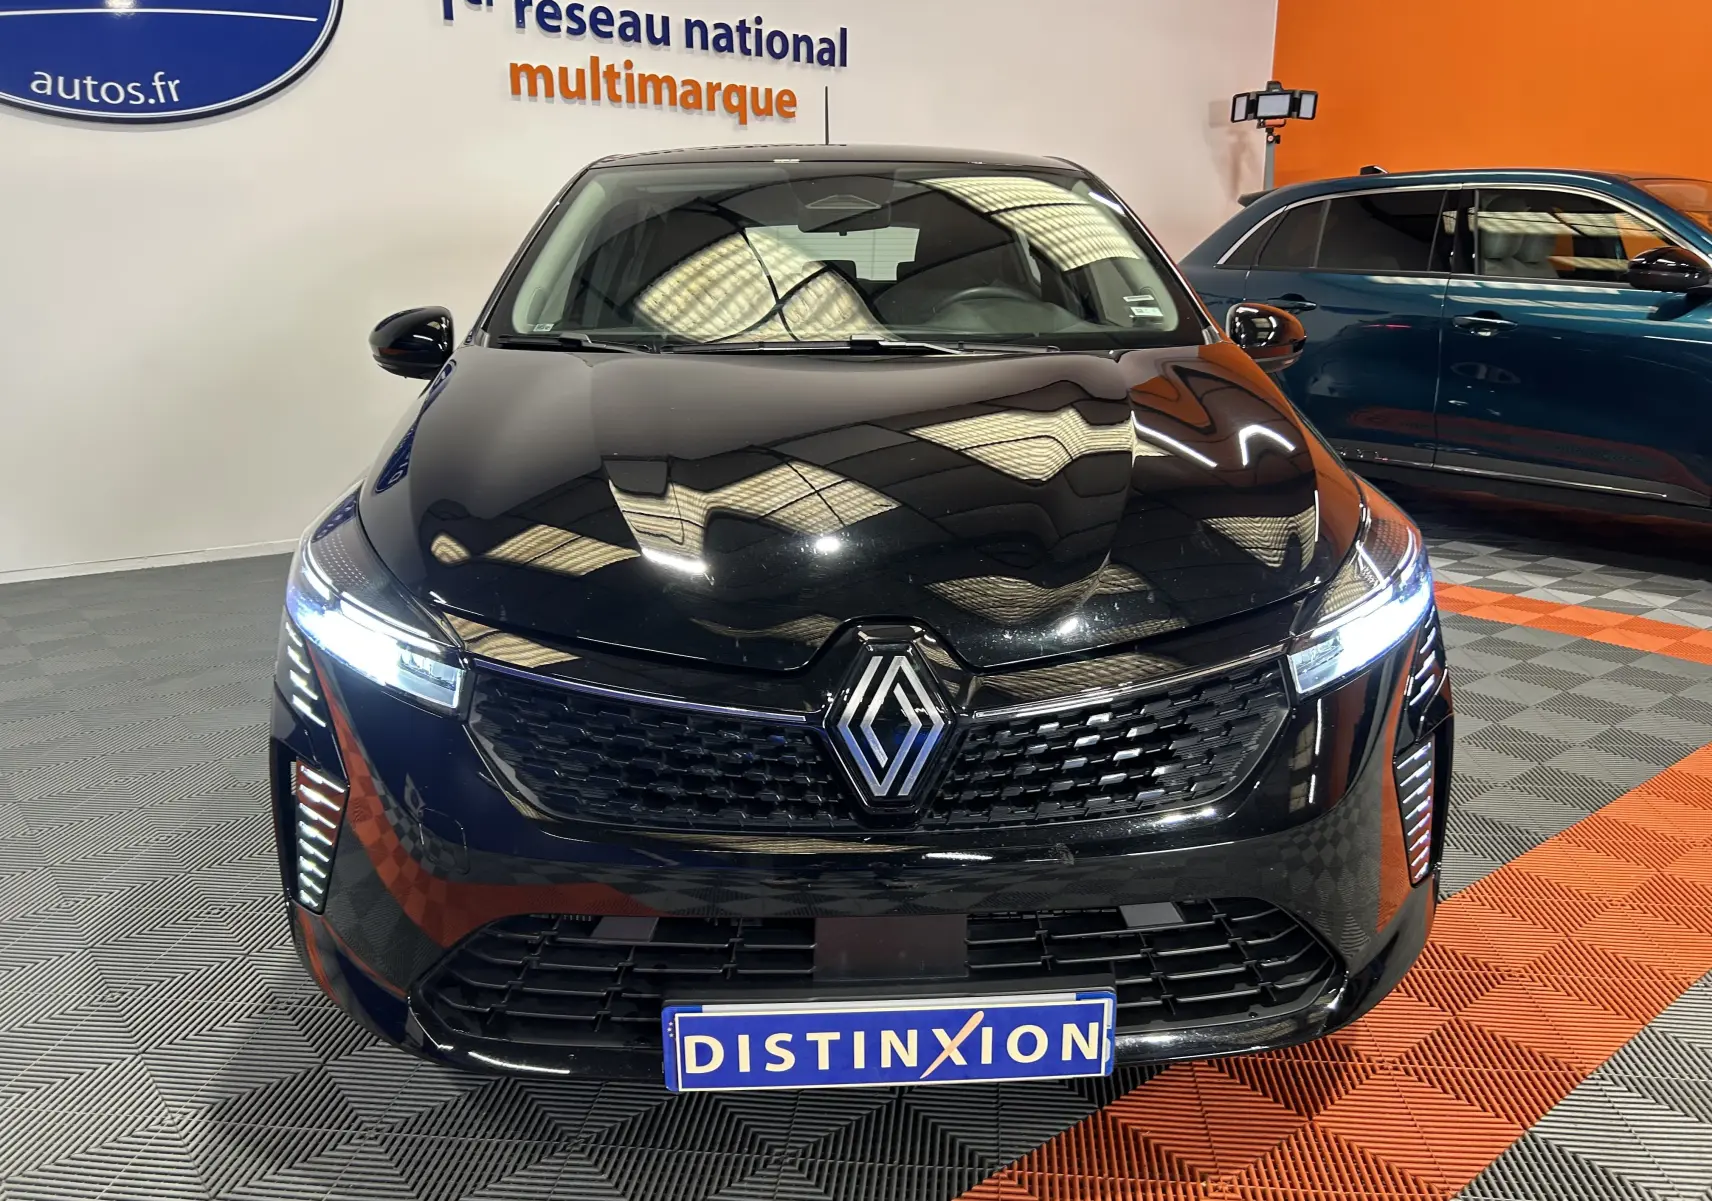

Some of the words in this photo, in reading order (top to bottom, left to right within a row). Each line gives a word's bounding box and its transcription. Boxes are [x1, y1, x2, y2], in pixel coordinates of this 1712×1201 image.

[684, 16, 848, 68] national
[30, 71, 181, 105] autos.fr
[509, 55, 798, 125] multimarque
[683, 1010, 1099, 1079] DISTINXION
